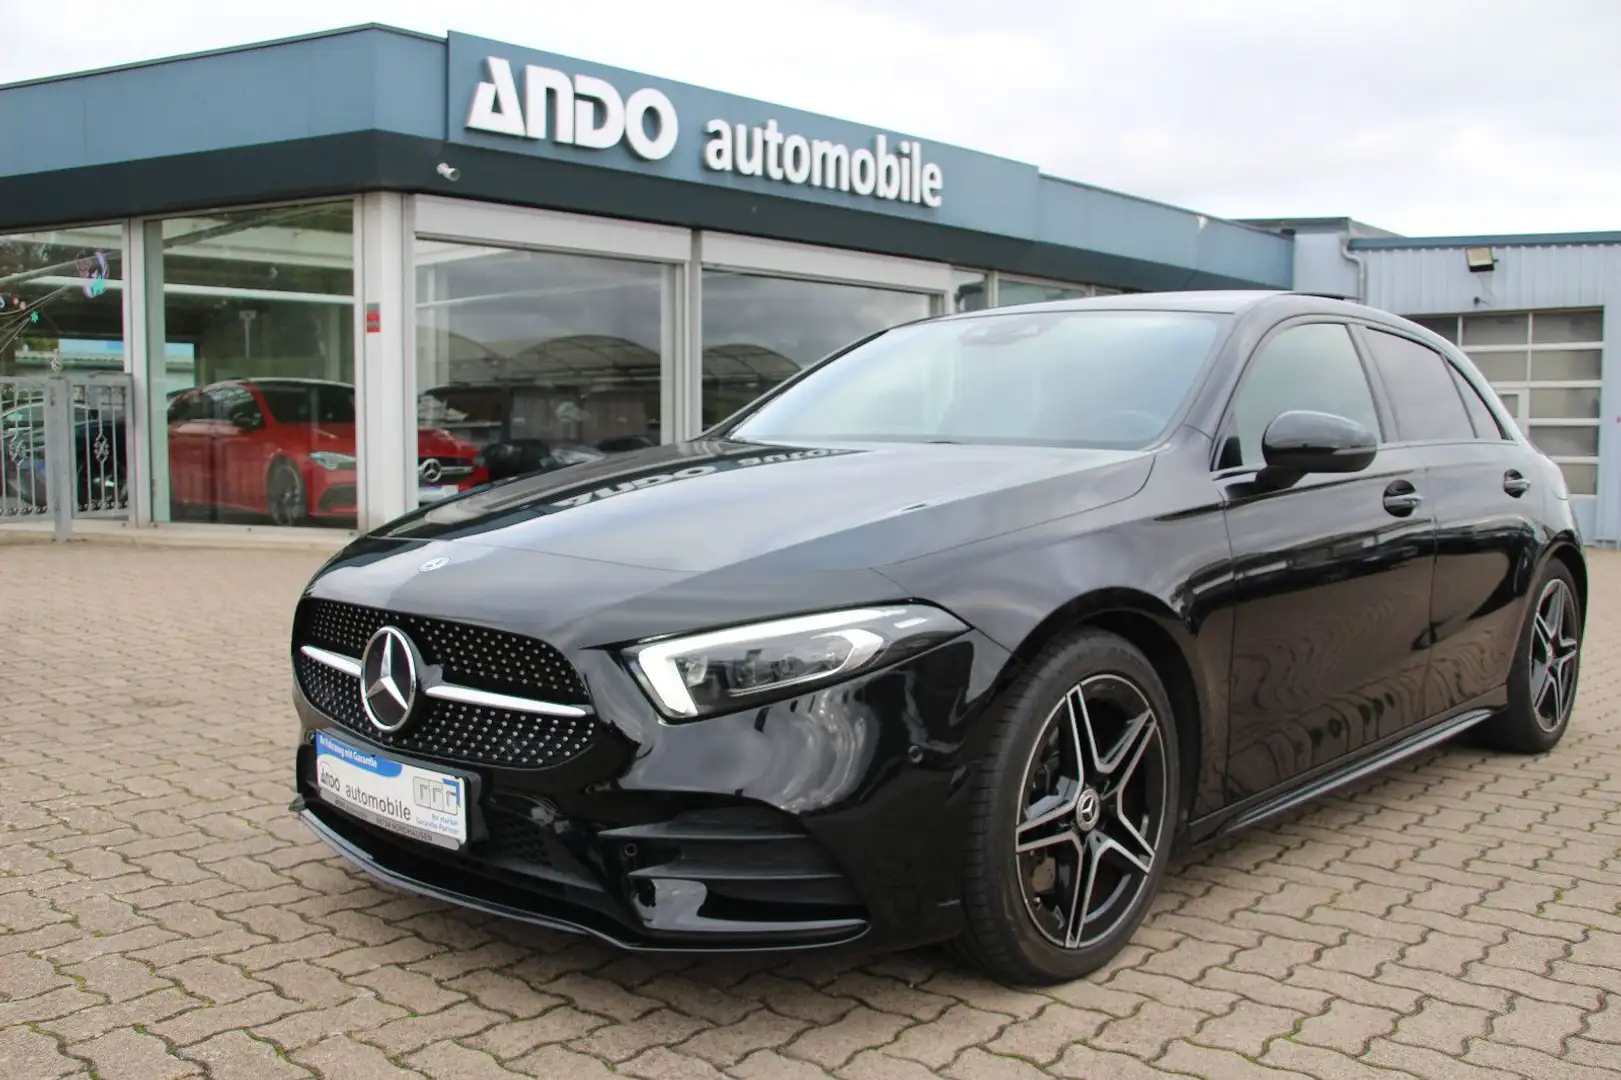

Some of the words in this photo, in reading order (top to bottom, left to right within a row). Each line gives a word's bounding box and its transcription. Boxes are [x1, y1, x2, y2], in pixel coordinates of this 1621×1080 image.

[465, 55, 679, 161] ANDO
[704, 118, 943, 208] automobile
[353, 751, 378, 769] Garantie
[321, 768, 340, 791] ANDO
[345, 784, 411, 820] automobile
